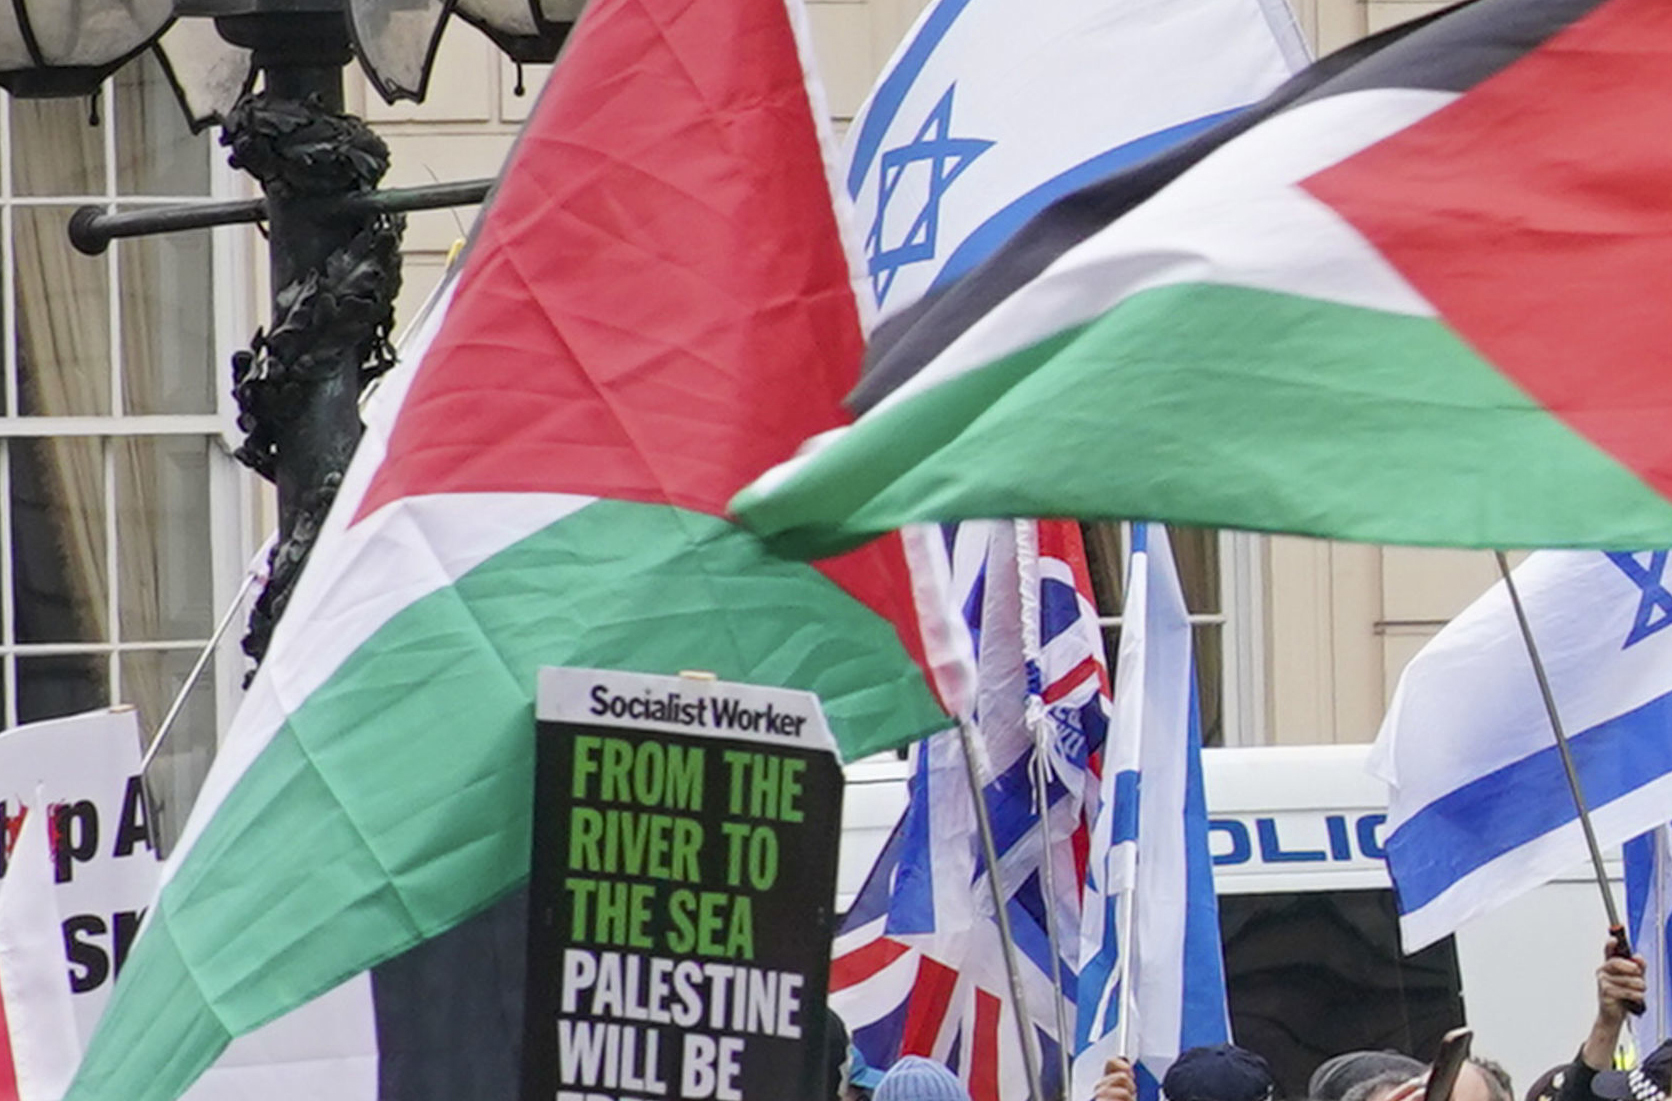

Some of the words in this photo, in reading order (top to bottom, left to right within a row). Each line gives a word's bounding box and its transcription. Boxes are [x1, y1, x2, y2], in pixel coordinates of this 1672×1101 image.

[590, 684, 707, 727] Socialist
[711, 697, 806, 737] Worker
[572, 735, 705, 812] FROM
[723, 750, 807, 823] THE
[569, 807, 704, 884] RIVER
[722, 822, 780, 891] TO
[1207, 814, 1388, 866] OLIC
[565, 877, 655, 948] THE
[667, 888, 754, 960] SEA
[562, 948, 804, 1040] PALESTINE
[557, 1019, 667, 1095] WILL
